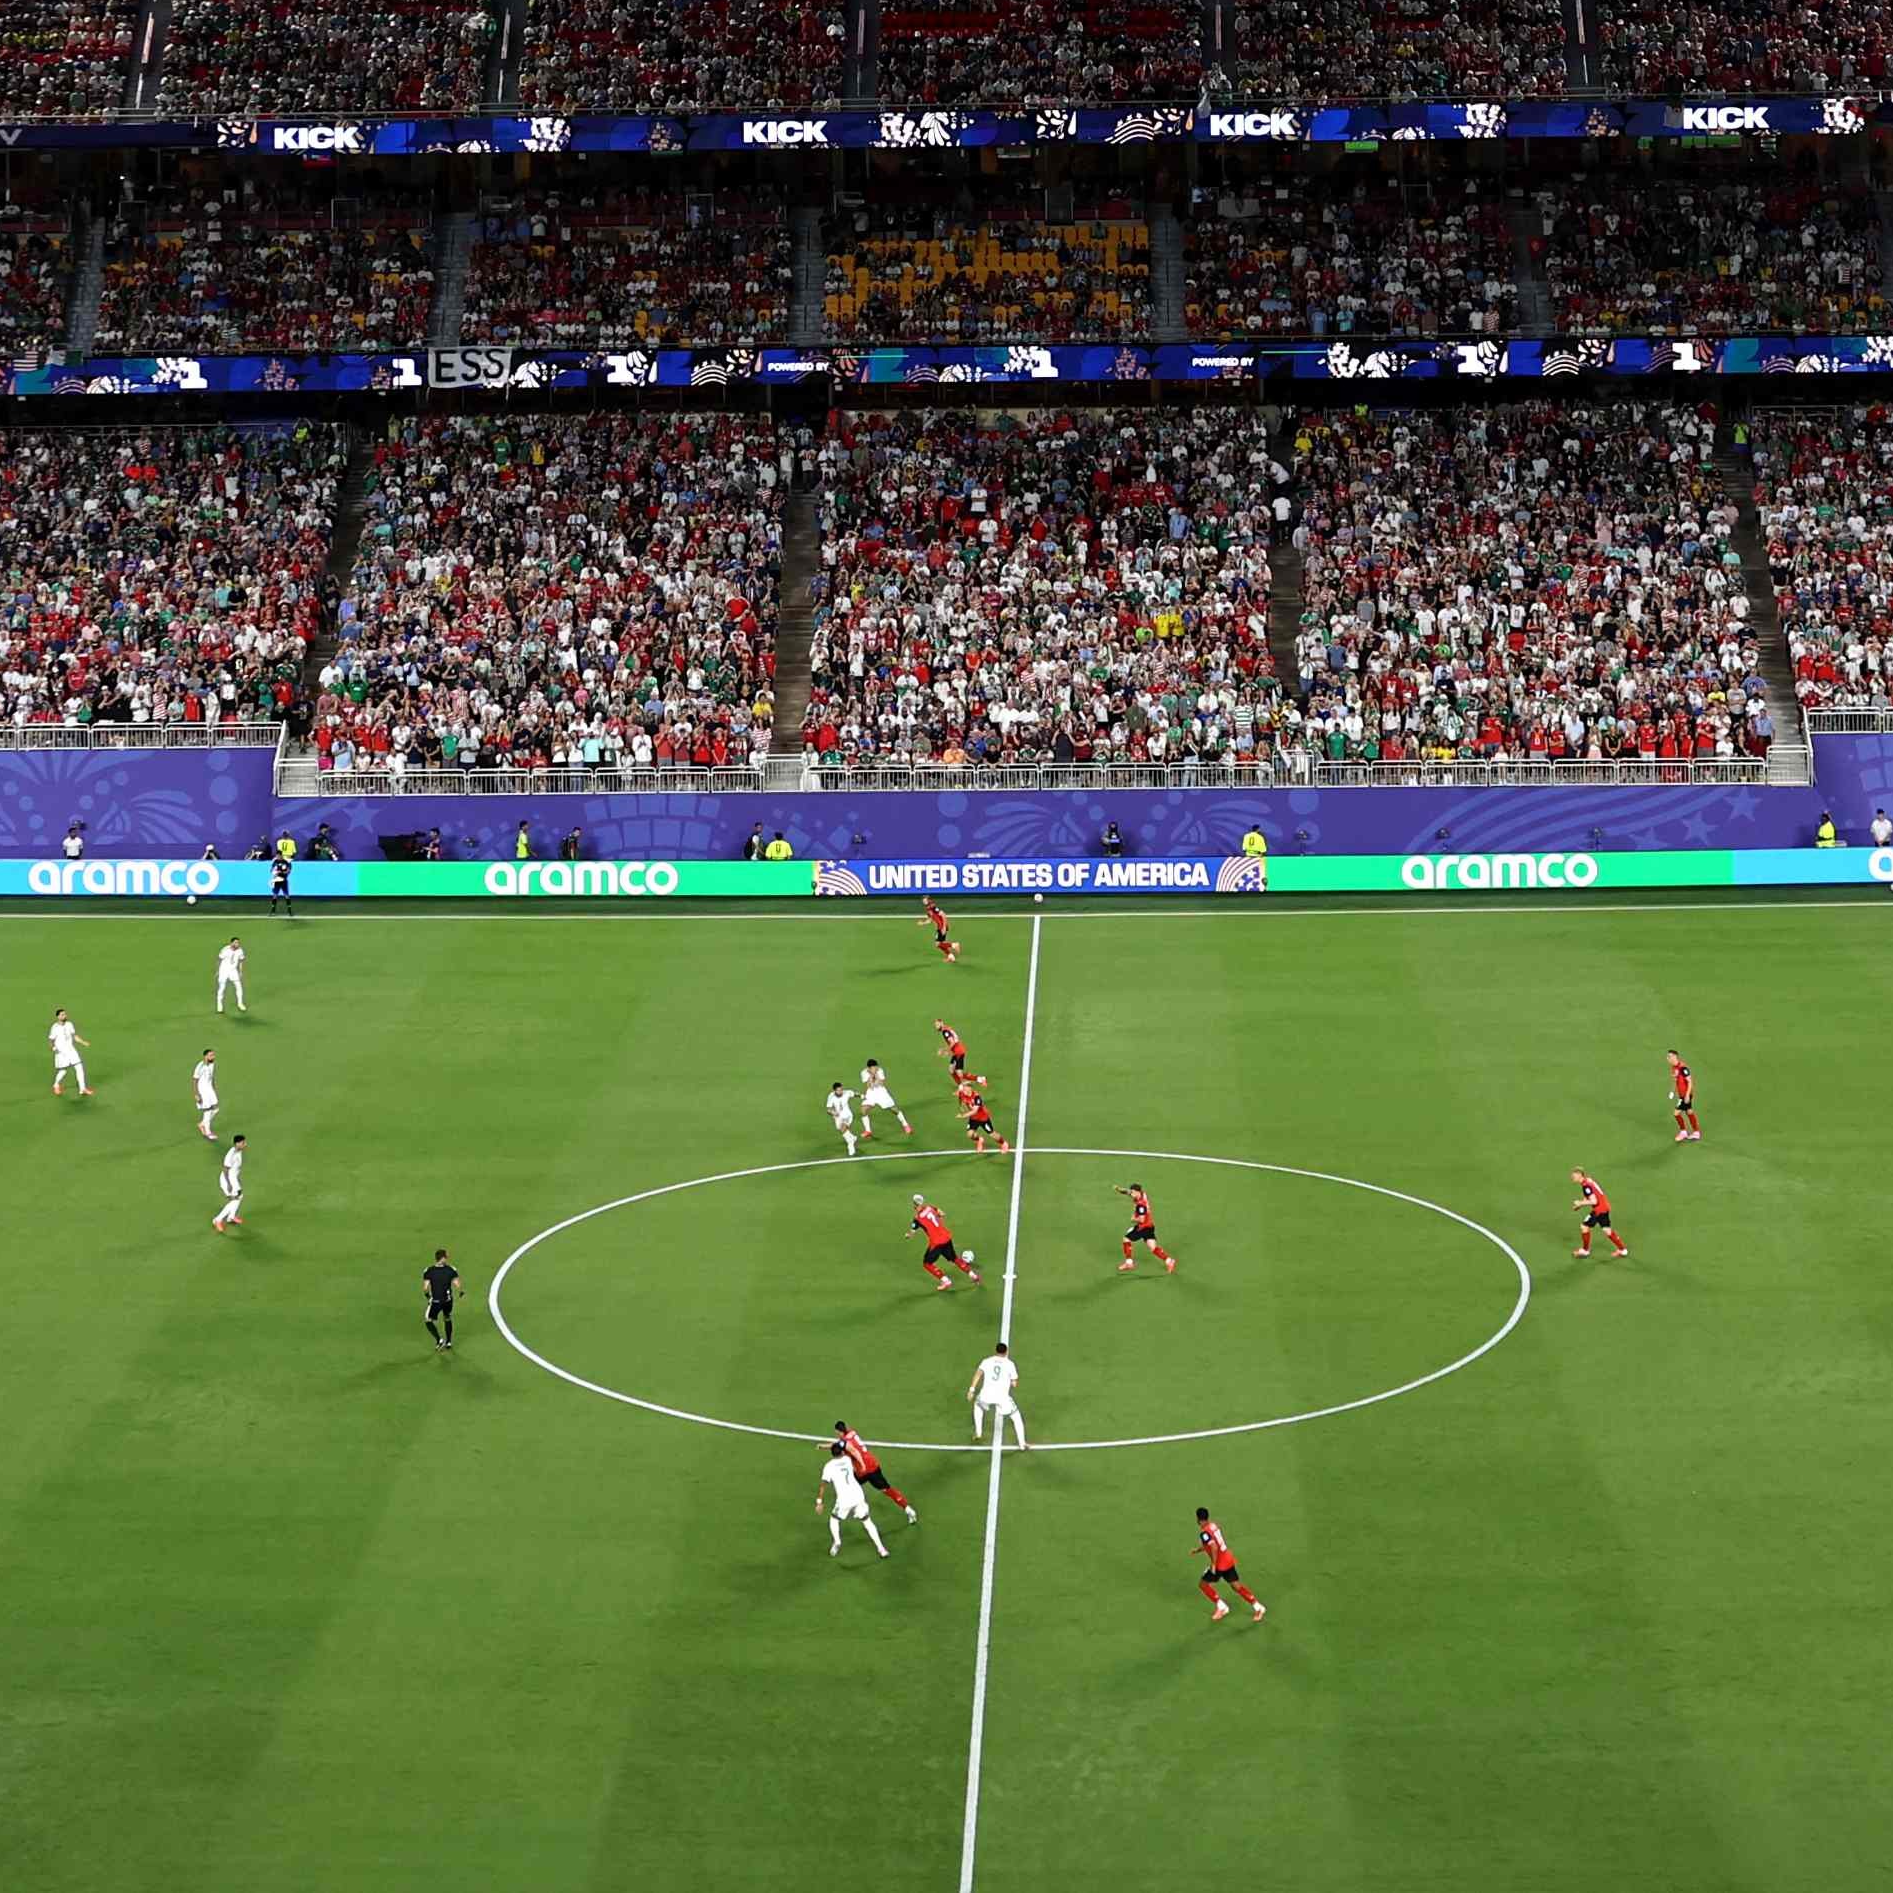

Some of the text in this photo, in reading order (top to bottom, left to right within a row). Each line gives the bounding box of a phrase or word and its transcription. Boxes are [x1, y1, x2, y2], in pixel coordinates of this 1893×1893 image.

[1210, 113, 1295, 136] KICK
[1683, 107, 1769, 129] KICK
[274, 126, 359, 149] KICK
[743, 120, 828, 143] KICK
[433, 349, 505, 382] ESS
[815, 362, 829, 372] BY
[1240, 357, 1254, 367] BY
[29, 861, 219, 895] aramco
[485, 861, 678, 895] aramco
[869, 862, 1209, 889] UNITED STATES OF AMERICA
[1402, 854, 1598, 889] aramco
[992, 1365, 1002, 1381] 9
[841, 1467, 850, 1486] 7
